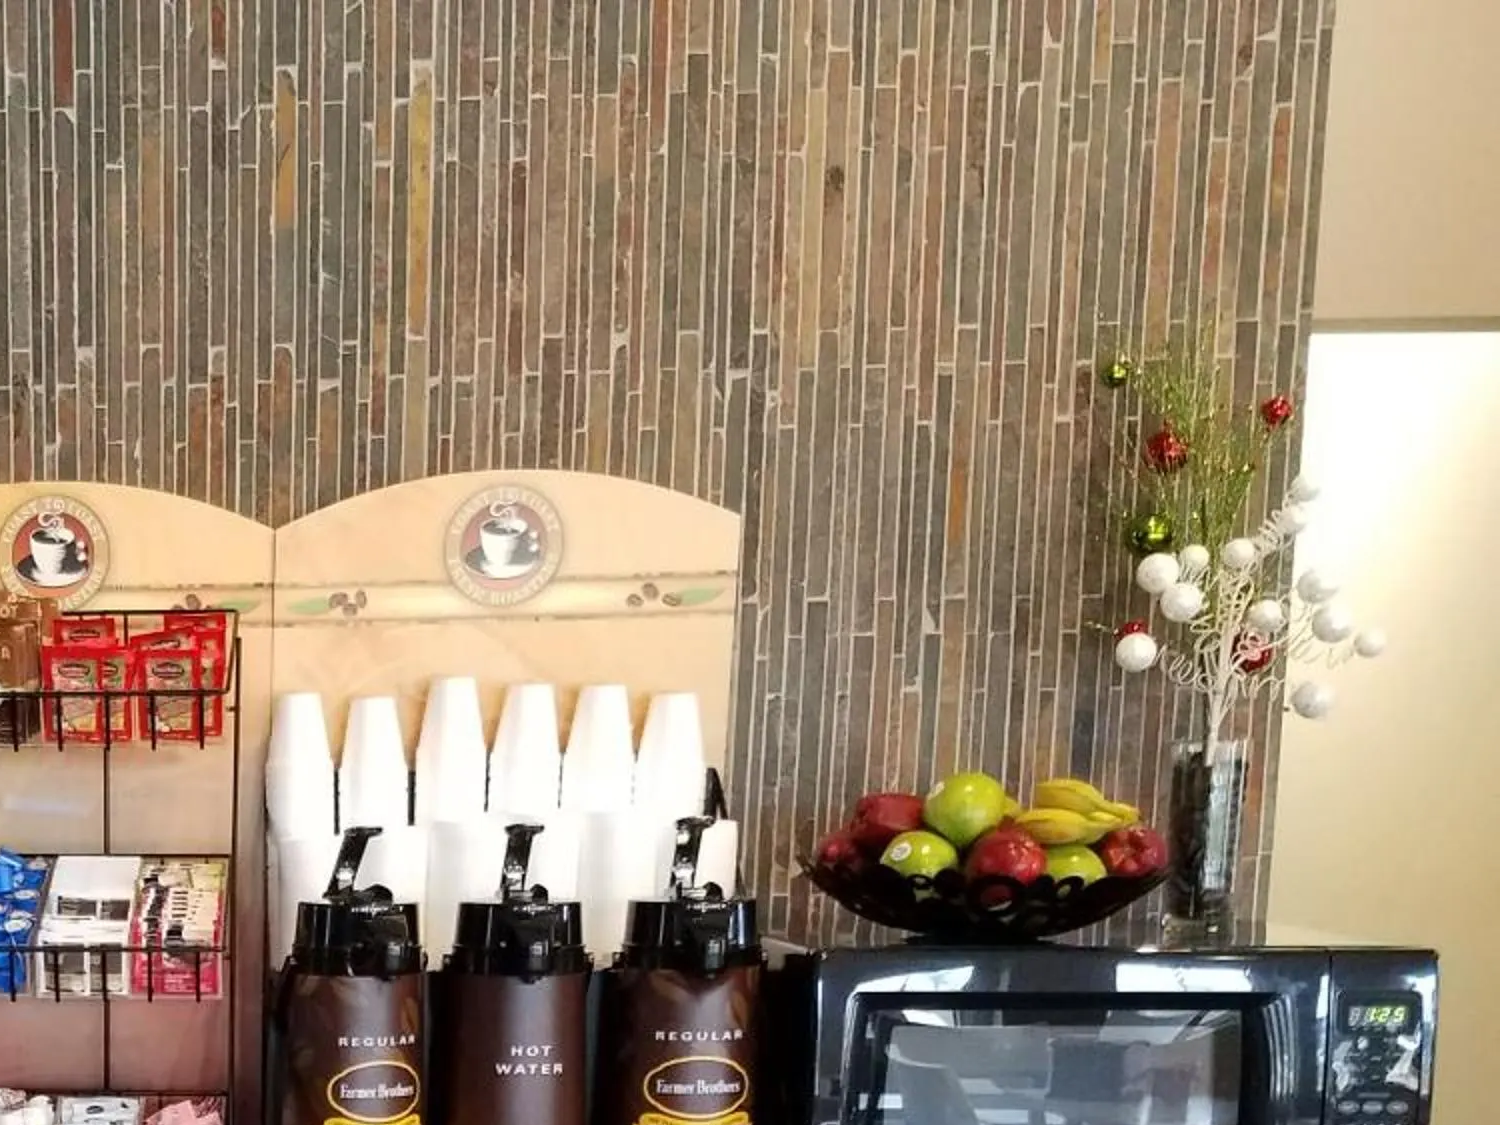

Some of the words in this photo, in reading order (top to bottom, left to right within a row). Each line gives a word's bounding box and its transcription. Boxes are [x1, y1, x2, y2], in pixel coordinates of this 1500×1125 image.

[338, 1033, 416, 1048] REGULAR
[654, 1028, 745, 1042] REGULAR
[510, 1044, 553, 1058] HOT
[494, 1062, 564, 1076] WATER
